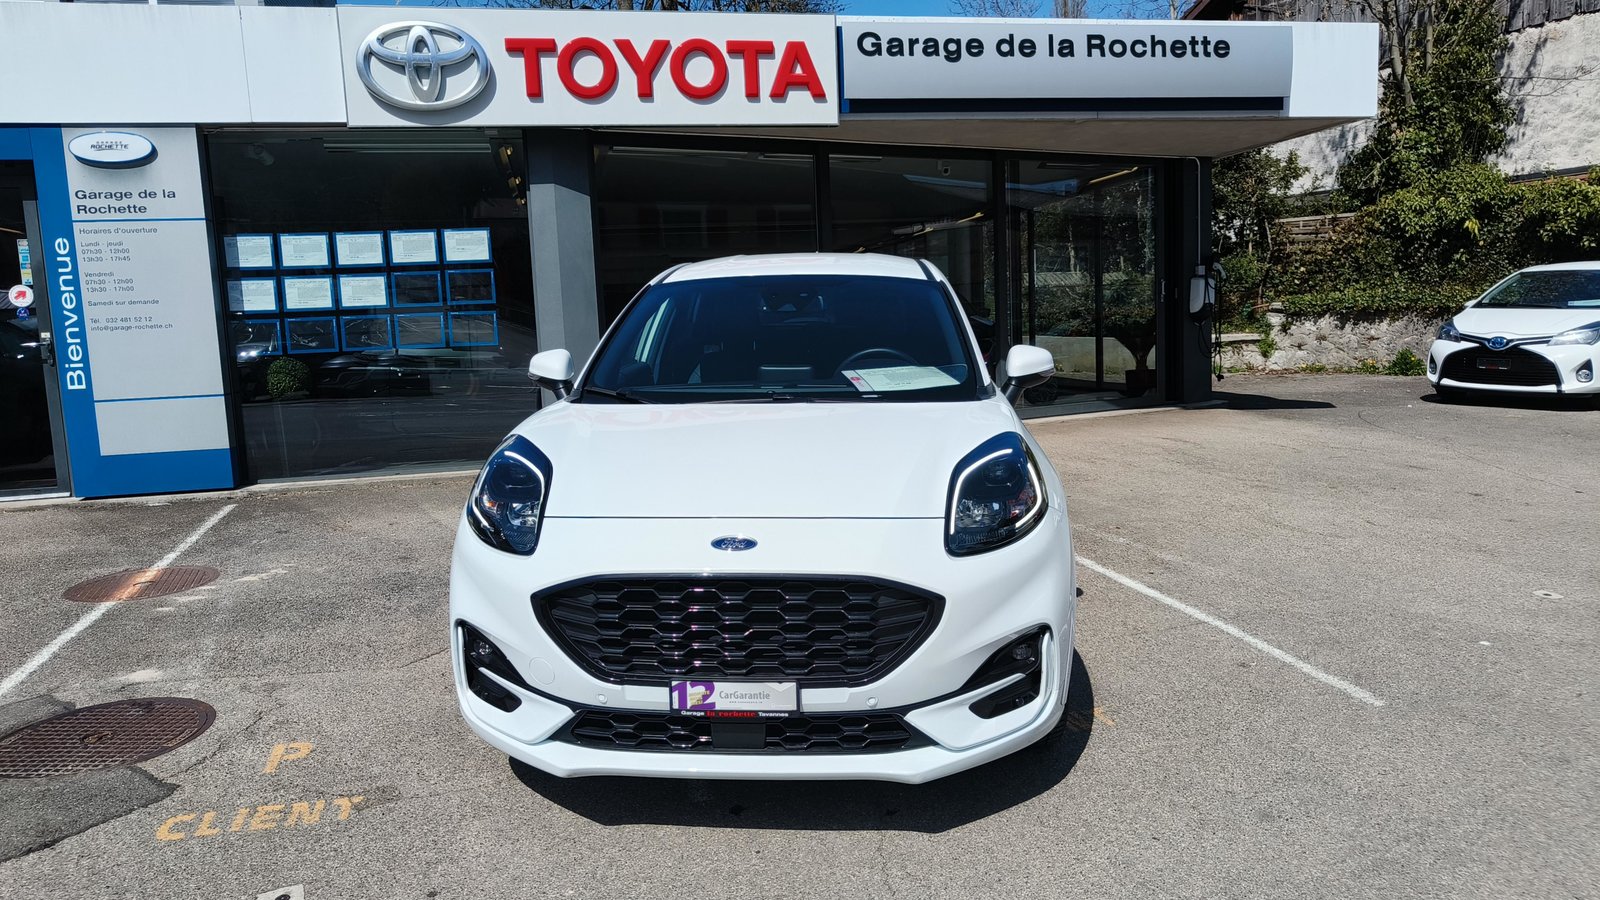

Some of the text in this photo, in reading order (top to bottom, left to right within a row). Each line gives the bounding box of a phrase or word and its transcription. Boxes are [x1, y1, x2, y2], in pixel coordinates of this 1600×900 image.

[856, 31, 1231, 63] Garage de la Rochette
[504, 37, 826, 103] TOYOTA
[75, 189, 176, 201] Garage de la
[76, 204, 147, 214] Rochette
[55, 237, 87, 390] Bienvenue
[672, 681, 716, 710] 12
[719, 690, 770, 700] CarGarantie
[262, 742, 313, 774] P
[155, 795, 365, 842] CLIENT
